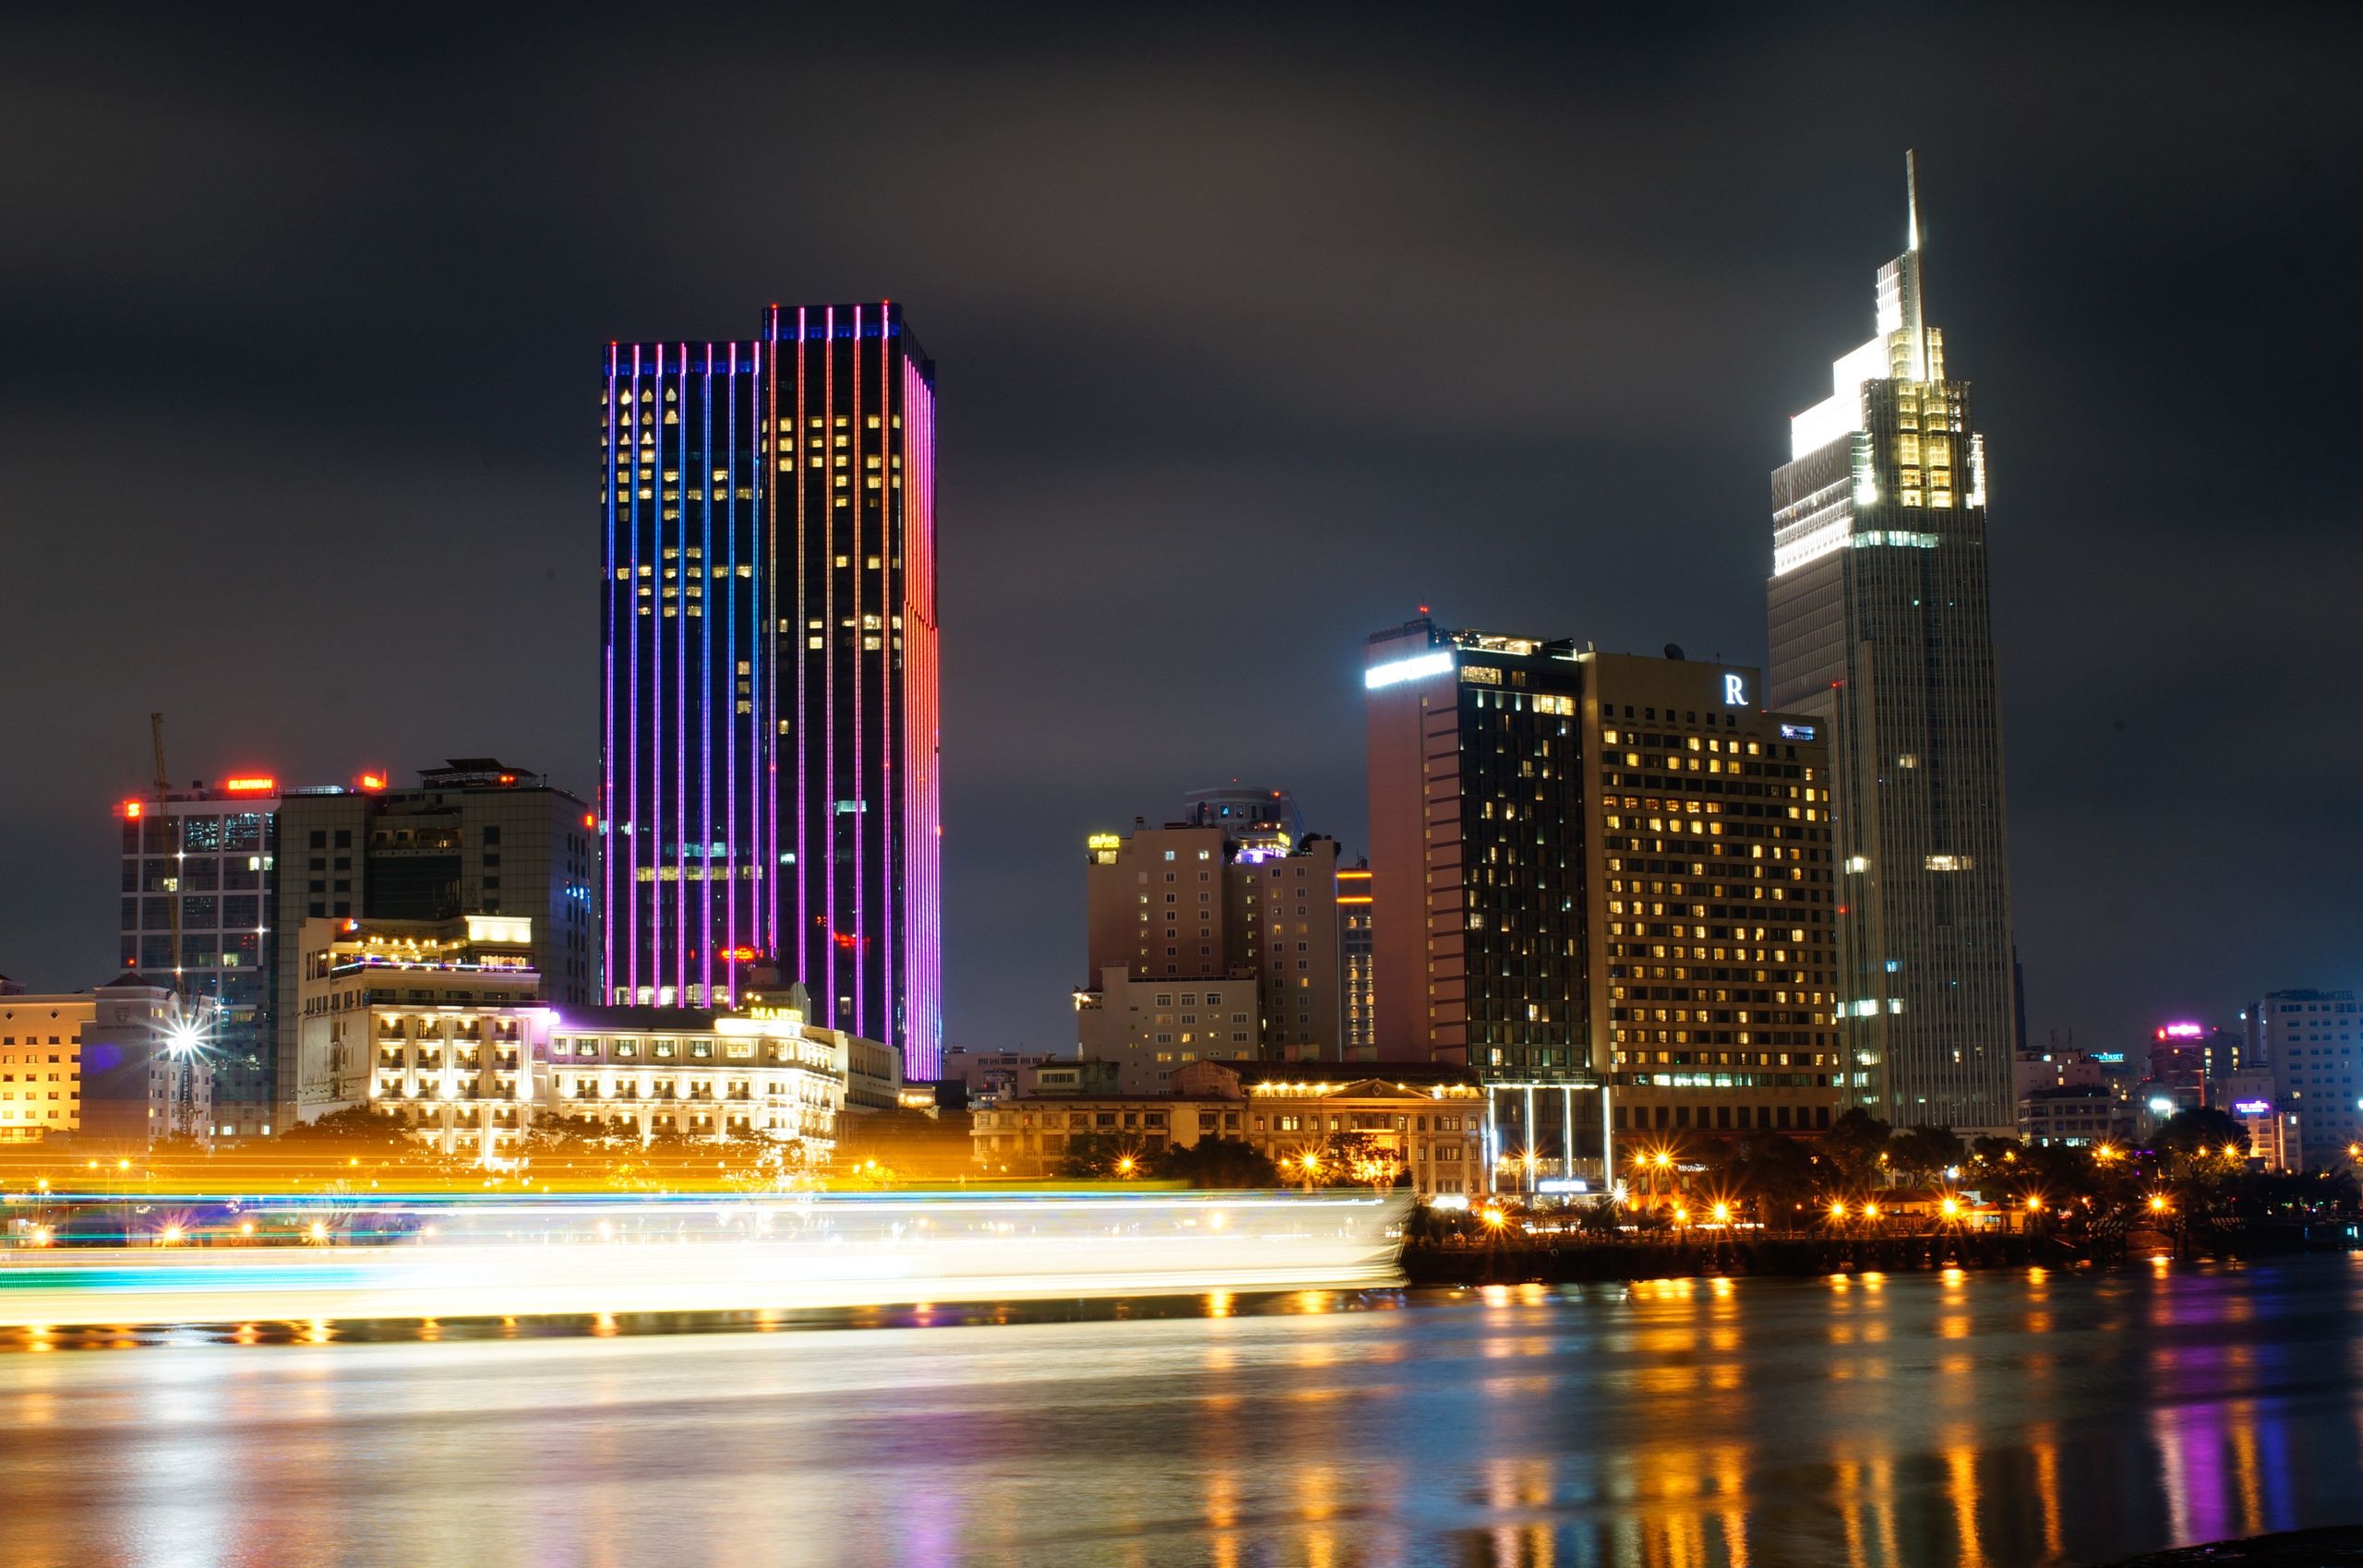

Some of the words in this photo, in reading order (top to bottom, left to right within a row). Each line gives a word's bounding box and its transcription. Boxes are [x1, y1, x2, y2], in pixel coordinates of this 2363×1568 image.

[1724, 674, 1748, 706] R
[228, 779, 272, 790] SUNWAH
[750, 1008, 803, 1023] MAJESTI
